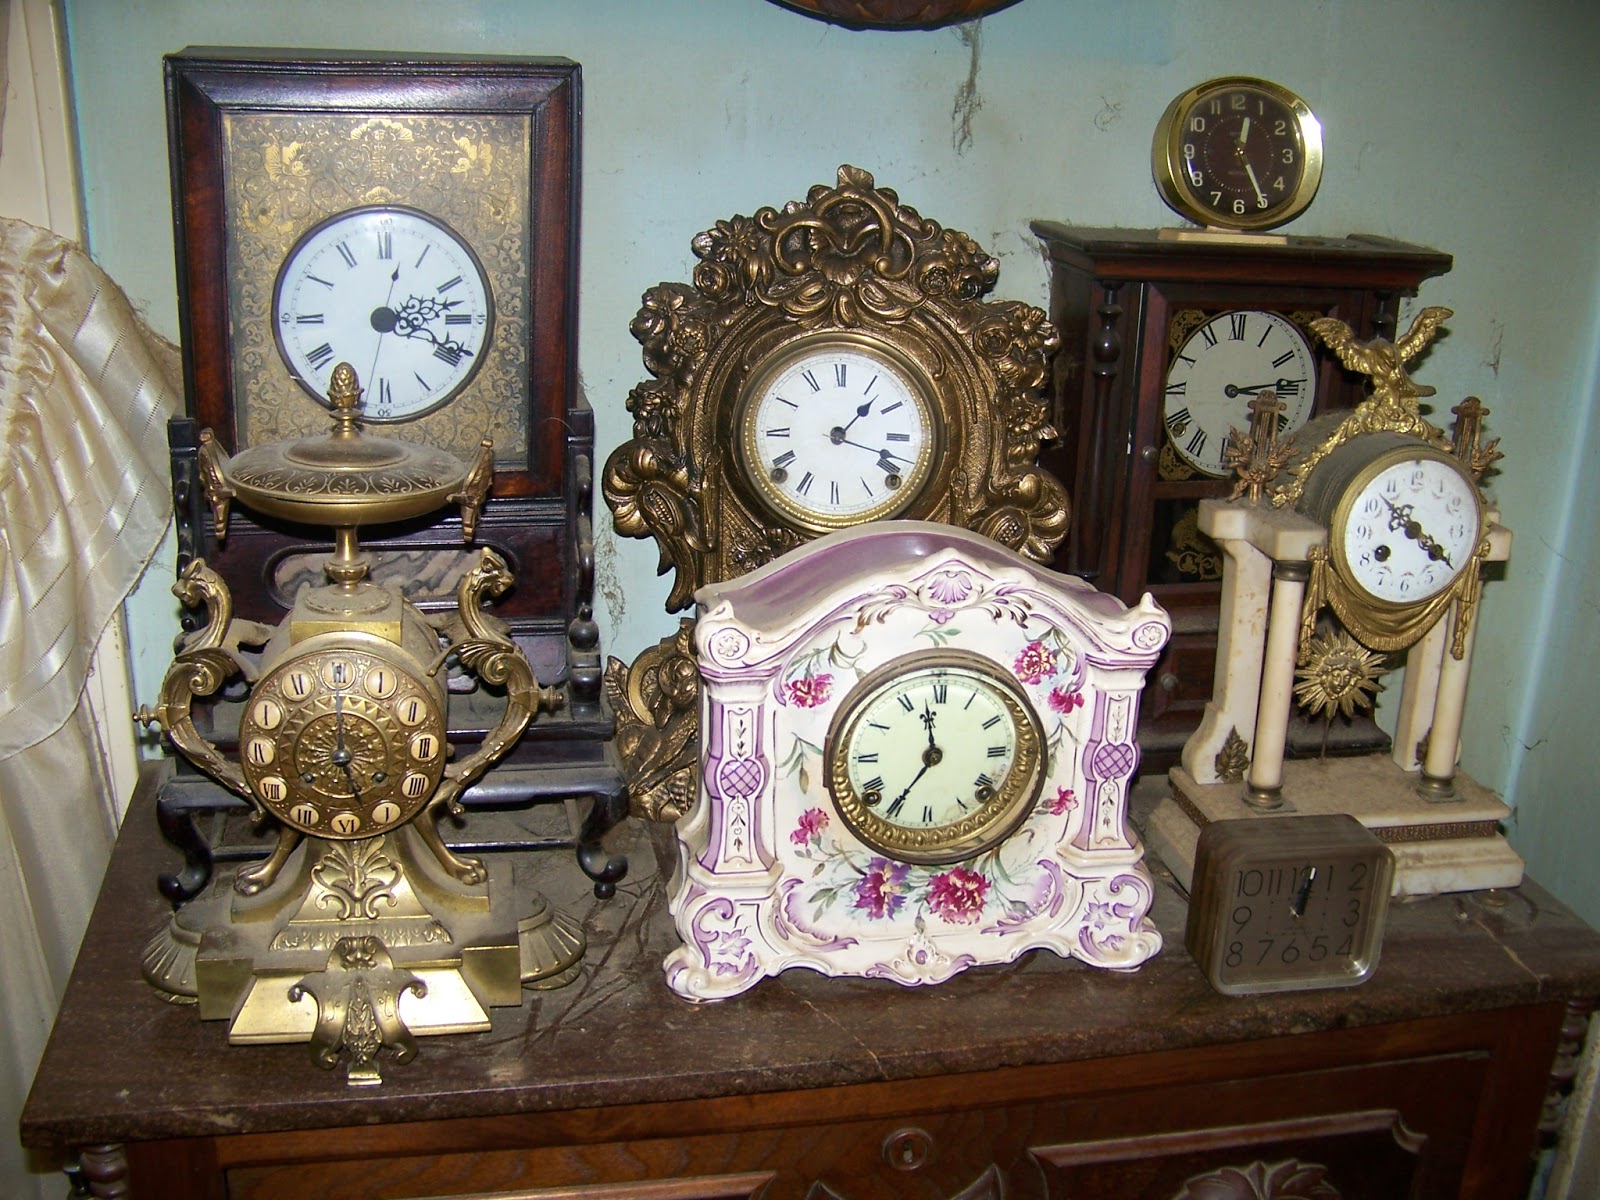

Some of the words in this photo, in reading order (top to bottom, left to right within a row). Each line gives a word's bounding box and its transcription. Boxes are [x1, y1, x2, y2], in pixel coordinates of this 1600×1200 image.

[1211, 101, 1221, 114] 11
[1232, 95, 1246, 109] 12
[1259, 101, 1263, 115] 1
[1190, 118, 1205, 132] 10
[1274, 121, 1286, 135] 2
[1184, 144, 1194, 159] 9
[1282, 149, 1293, 163] 3
[1192, 172, 1203, 186] 8
[1273, 176, 1285, 191] 4
[1210, 191, 1222, 206] 7
[1257, 194, 1267, 208] 5
[1233, 199, 1245, 214] 6
[415, 243, 431, 269] I
[436, 275, 463, 294] II
[445, 314, 472, 325] III
[1228, 314, 1247, 341] XII
[1257, 324, 1273, 348] I
[1271, 350, 1295, 368] II
[880, 401, 903, 415] II
[1364, 499, 1378, 513] 10
[1357, 525, 1366, 539] 9
[1455, 524, 1463, 538] 3
[1360, 552, 1370, 567] 8
[1425, 570, 1434, 584] 5
[1400, 581, 1409, 592] 6
[378, 672, 383, 694] I
[408, 701, 418, 722] II
[981, 715, 1001, 730] II
[418, 737, 431, 759] III
[987, 746, 1007, 758] III
[263, 782, 280, 800] VIII
[407, 777, 426, 796] IIII
[338, 819, 355, 833] VI
[1237, 870, 1263, 897] 10
[1268, 869, 1283, 896] 11
[1327, 865, 1333, 891] 1
[1350, 863, 1367, 892] 2
[1232, 906, 1252, 934] 9
[1343, 899, 1360, 927] 3
[1256, 939, 1274, 966] 7
[1282, 938, 1300, 964] 6
[1309, 936, 1328, 961] 5
[1335, 935, 1354, 956] 4
[1225, 941, 1243, 968] 8
